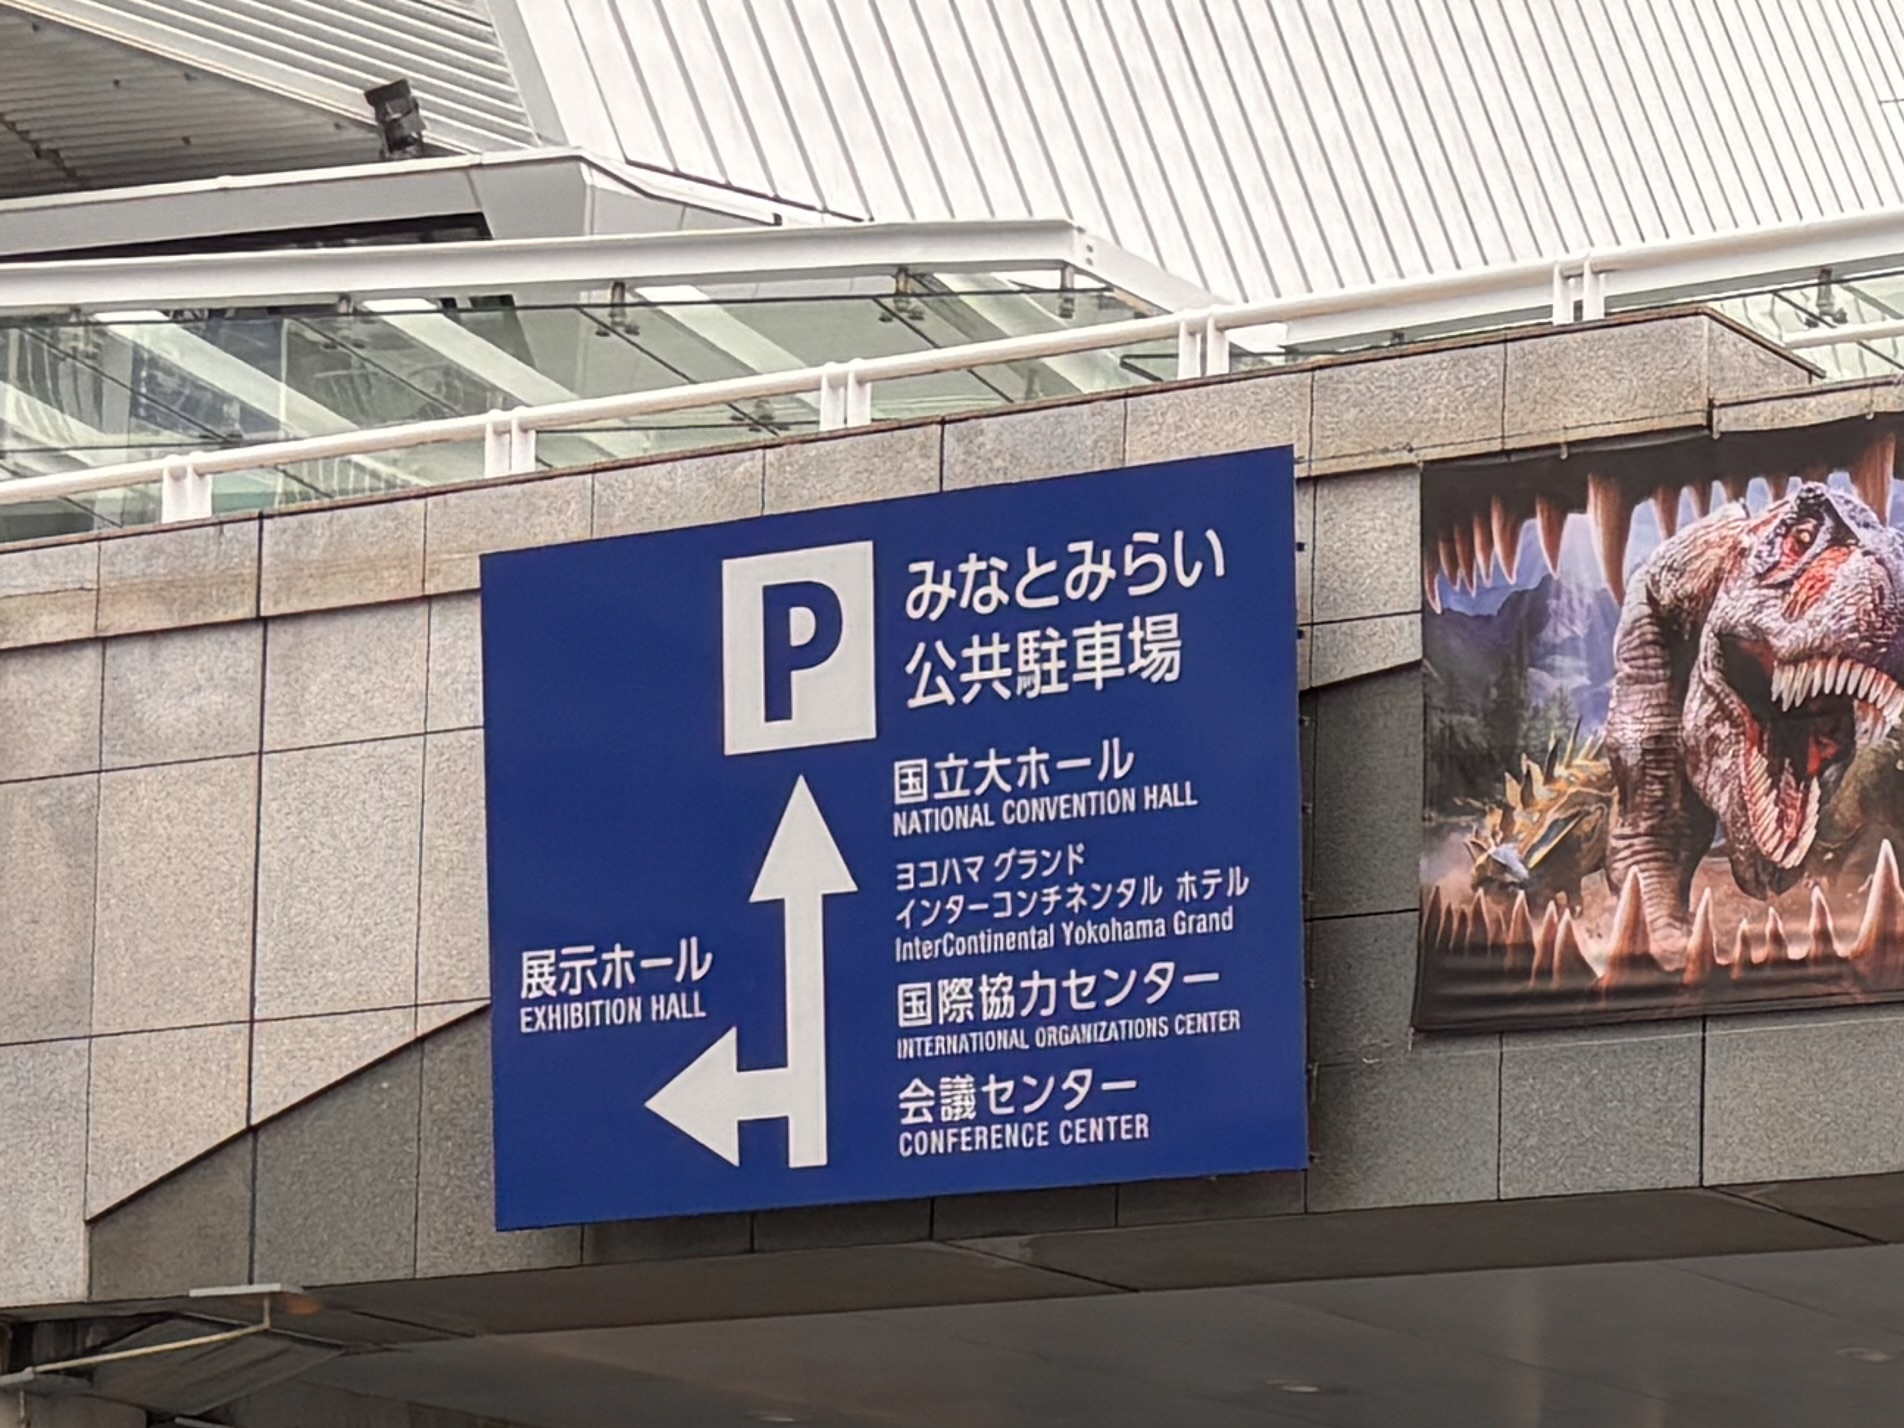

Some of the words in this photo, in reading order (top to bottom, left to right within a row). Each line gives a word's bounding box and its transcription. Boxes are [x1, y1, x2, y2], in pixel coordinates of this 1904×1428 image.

[904, 528, 1226, 620] みなとみらい
[762, 580, 843, 724] P
[906, 614, 1183, 710] 公共駐車場
[894, 738, 1134, 804] 国立大ホール
[893, 801, 995, 836] NATIONAL
[1002, 788, 1136, 826] CONVENTION
[1143, 781, 1197, 814] HALL
[896, 852, 984, 891] ヨコハマ
[995, 843, 1085, 882] グランド
[897, 876, 1162, 930] インターコンチネンタル
[1176, 865, 1250, 902] ホテル
[896, 919, 1054, 961] InterContinental
[1062, 913, 1166, 947] Yokohama
[1174, 905, 1233, 938] Grand
[520, 937, 713, 999] 展示ホール
[897, 960, 1219, 1029] 国際協力センター
[520, 997, 641, 1033] EXHIBITION
[651, 991, 706, 1023] HALL
[897, 1026, 1029, 1059] INTERNATIONAL
[1035, 1016, 1169, 1048] ORGANIZATIONS
[1175, 1008, 1240, 1037] CENTER
[899, 1068, 1137, 1125] 会議センター
[899, 1120, 1049, 1156] CONFERENCE
[1060, 1113, 1150, 1146] CENTER
